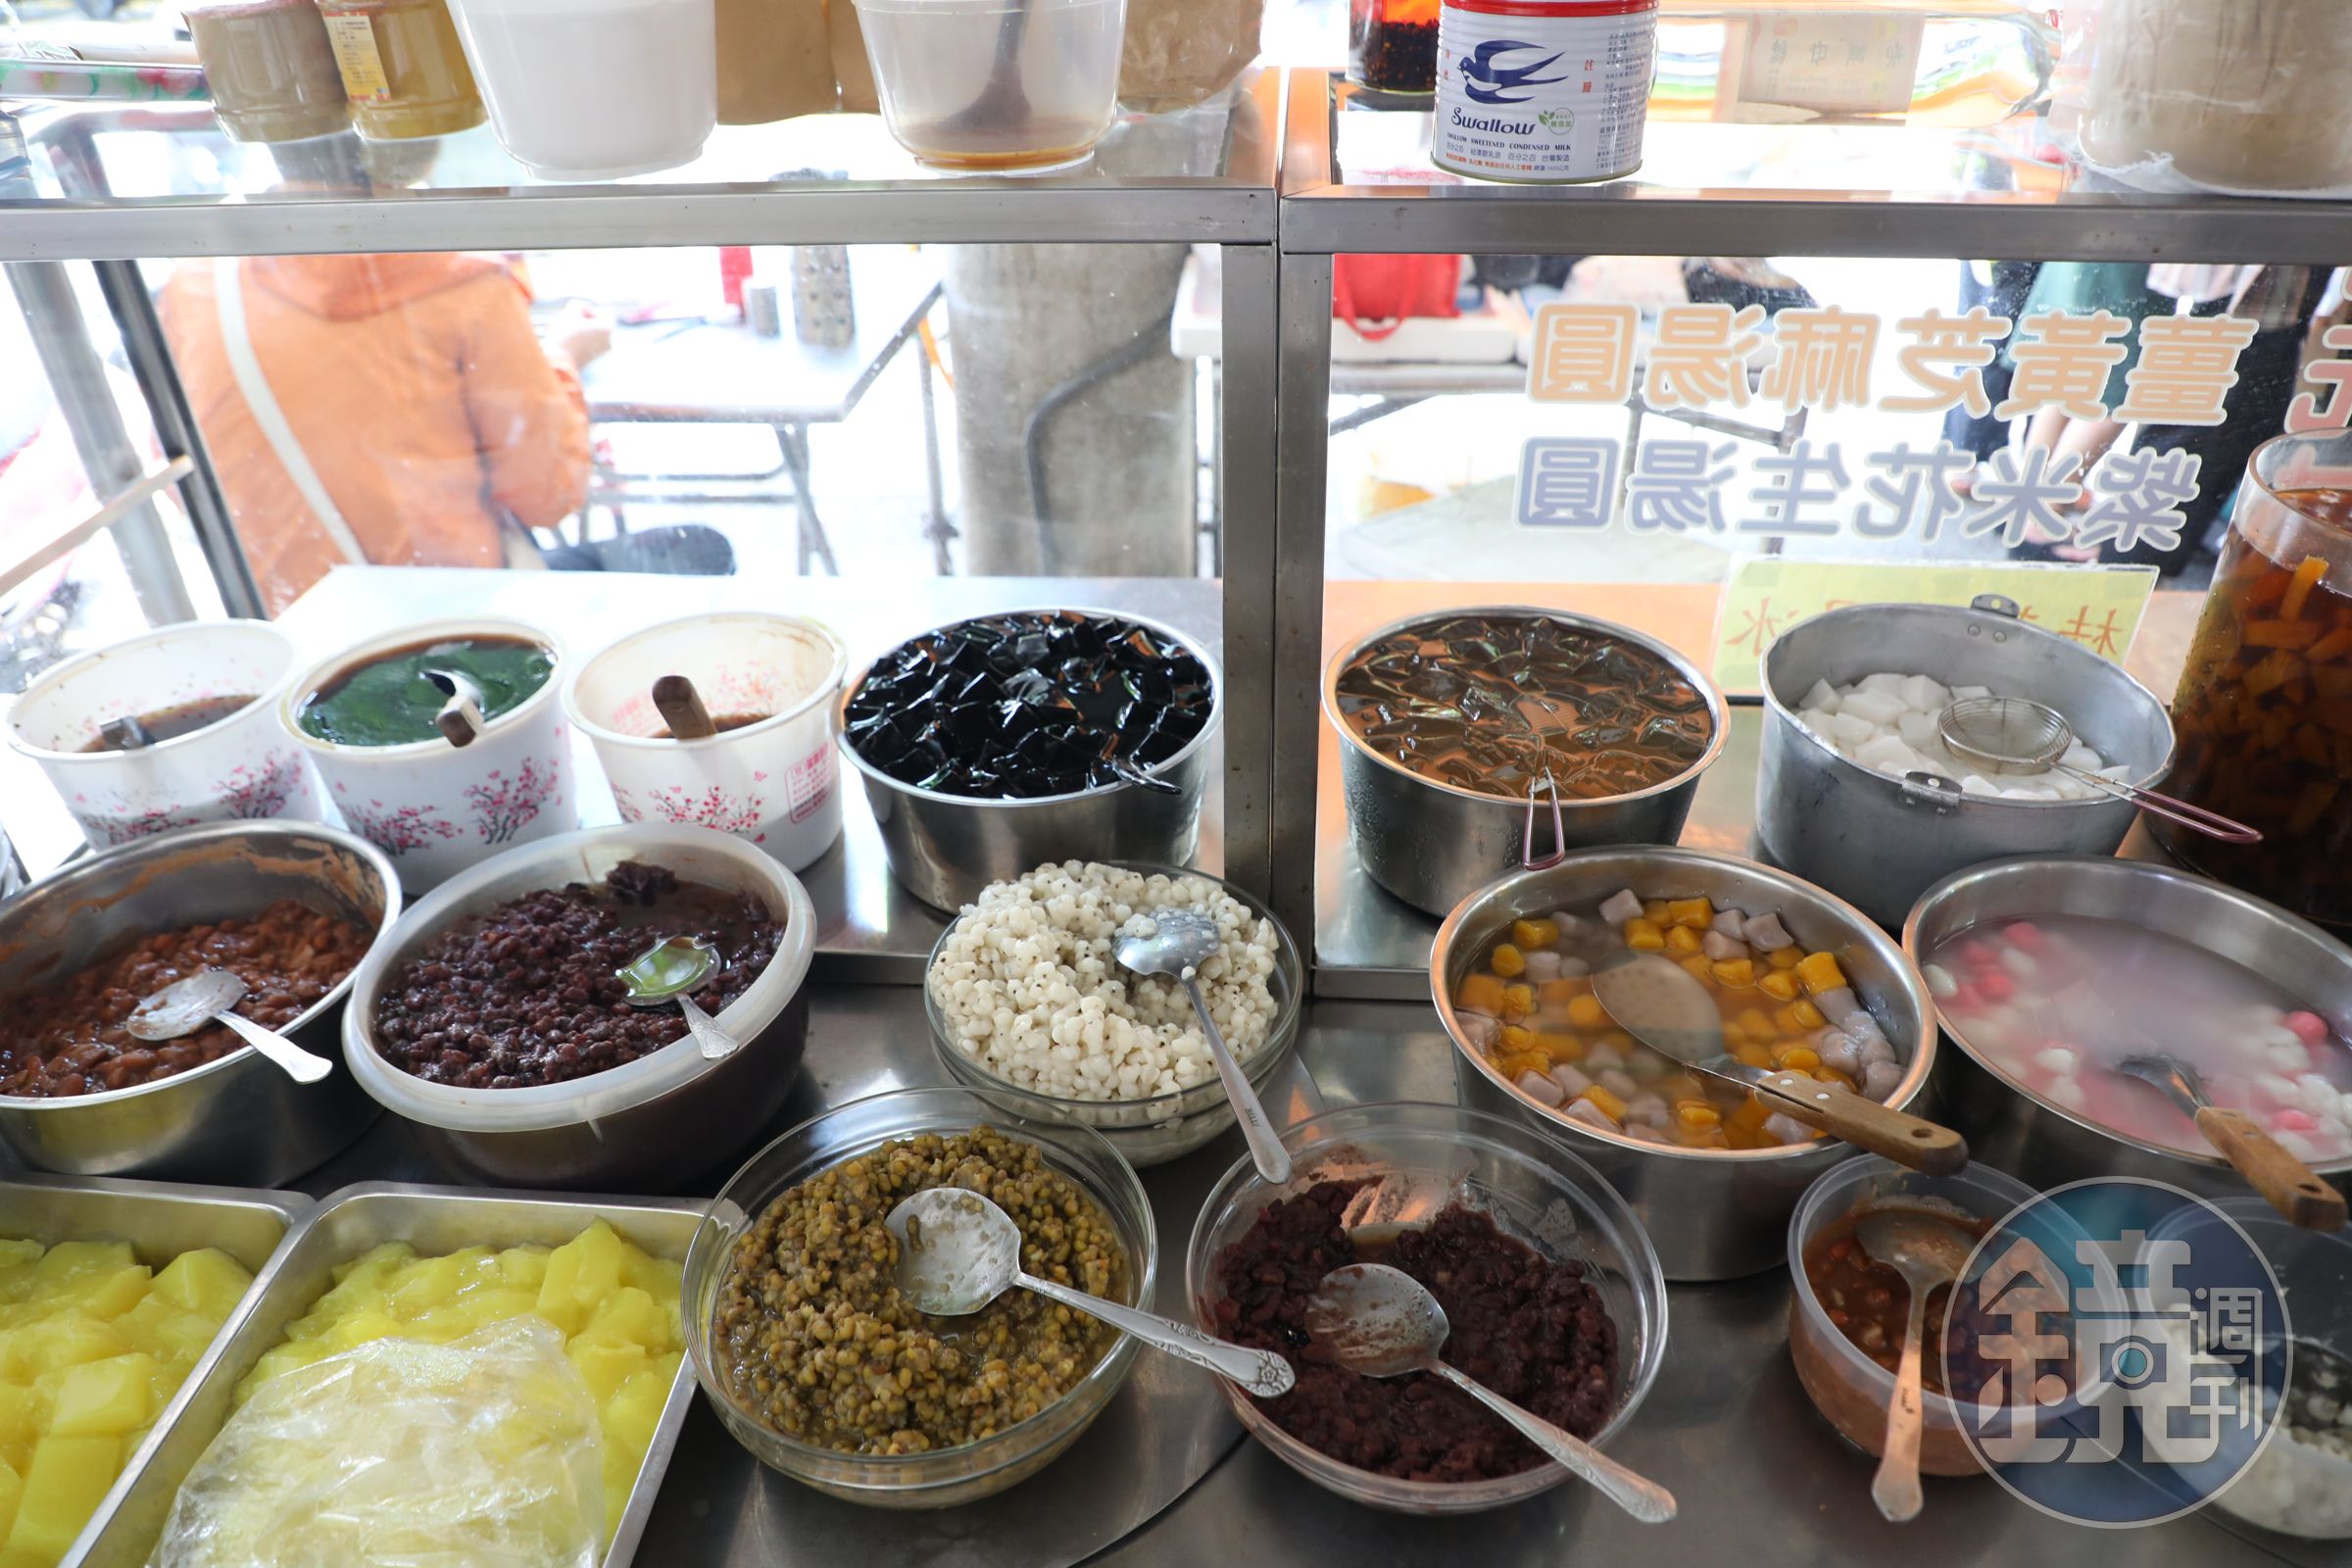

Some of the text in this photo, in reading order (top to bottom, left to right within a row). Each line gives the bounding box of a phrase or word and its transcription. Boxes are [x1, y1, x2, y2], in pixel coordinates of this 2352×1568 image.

[1451, 107, 1537, 135] Swallow
[1471, 138, 1505, 148] SWEETENED
[1509, 142, 1550, 151] CONDENSED
